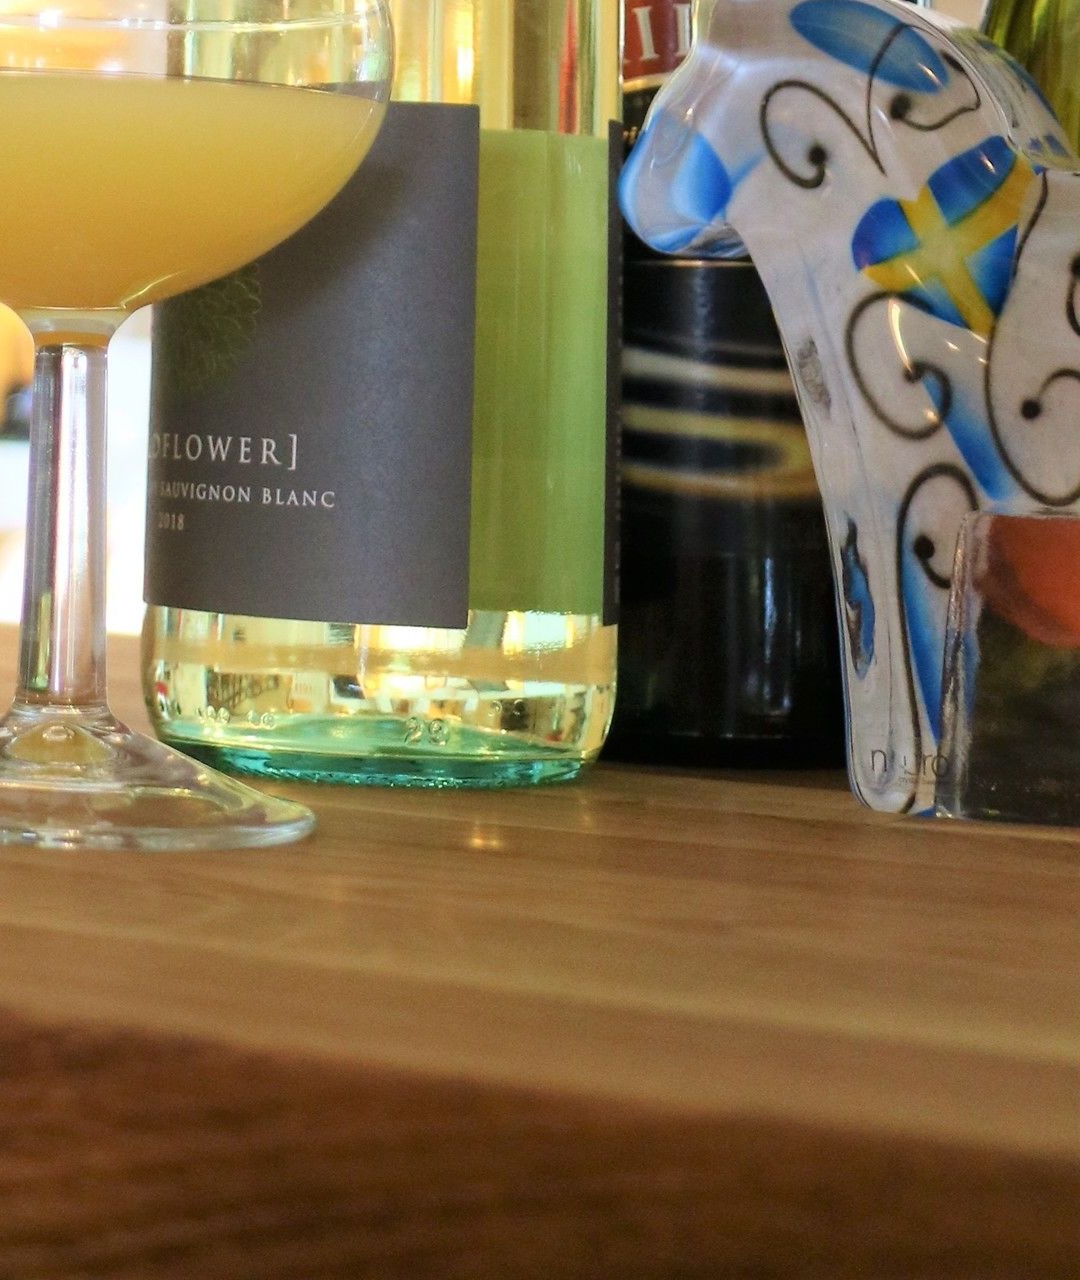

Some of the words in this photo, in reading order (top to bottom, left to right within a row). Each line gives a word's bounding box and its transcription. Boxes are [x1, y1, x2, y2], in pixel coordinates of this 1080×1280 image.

[149, 432, 298, 471] DFLOWER]
[262, 487, 336, 508] BLANC
[158, 512, 185, 531] 2018
